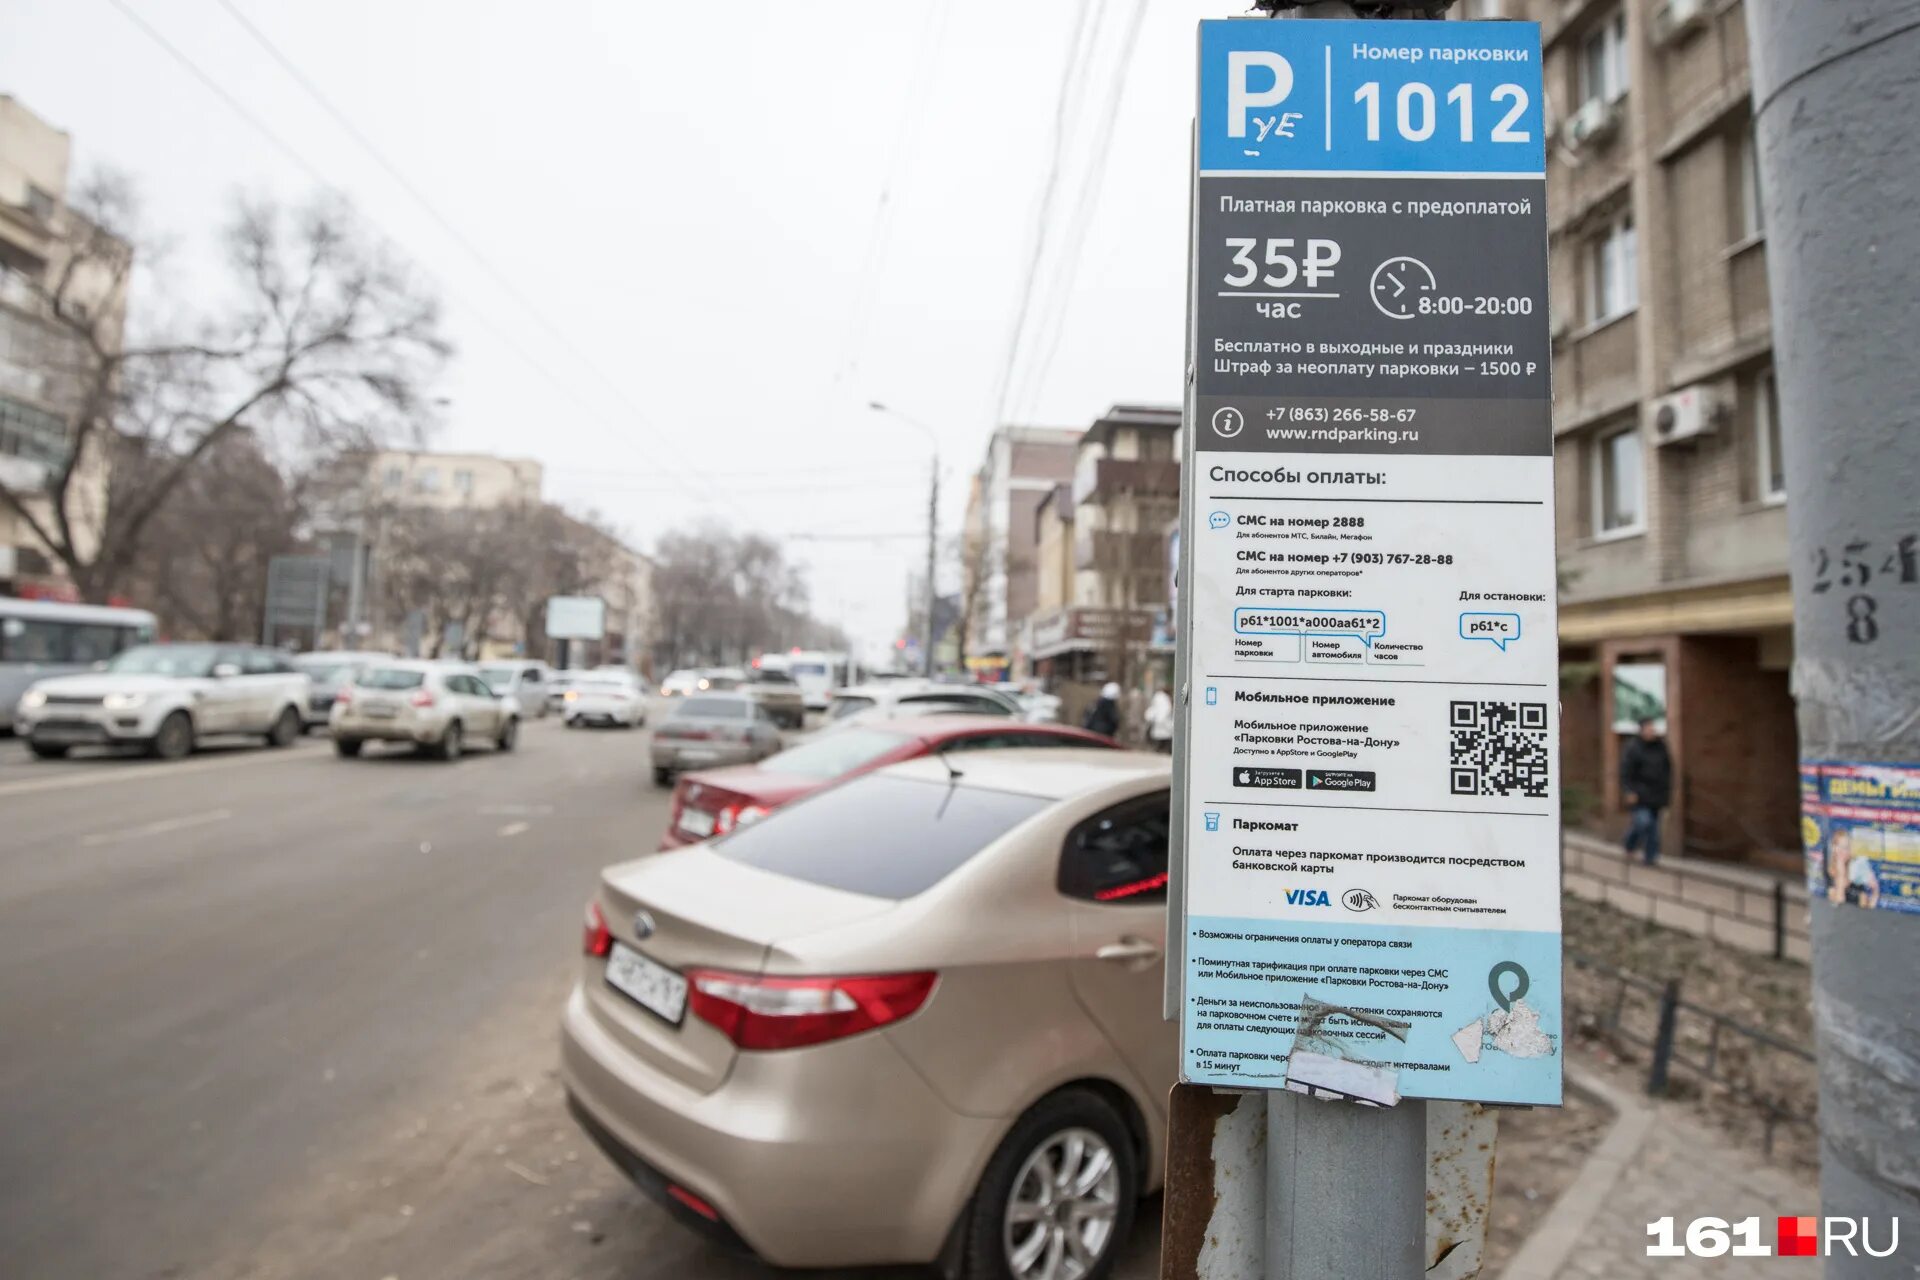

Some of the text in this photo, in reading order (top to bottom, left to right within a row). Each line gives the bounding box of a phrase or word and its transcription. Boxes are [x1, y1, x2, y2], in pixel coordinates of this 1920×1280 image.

[1353, 43, 1529, 65] Номер парковки
[1228, 51, 1296, 140] P
[1354, 82, 1530, 143] 1012
[1220, 195, 1531, 218] Платная парковка с предоплатой
[1255, 302, 1302, 319] час
[1214, 337, 1514, 359] Бесплатно в выходные и праздники
[1213, 358, 1272, 377] Штраф
[1275, 362, 1293, 374] за
[1296, 362, 1376, 379] неоплату
[1379, 363, 1460, 379] парковки
[1480, 361, 1522, 377] 1500
[1265, 406, 1417, 423] +7 (863) 266-58-67
[1265, 426, 1419, 445] www.rndparking.ru
[1209, 465, 1387, 485] Способы оплаты:
[1236, 514, 1365, 530] СМС на номер 2888
[1236, 530, 1372, 542] Для абонентов МТС, Билайн, Мегафон
[1236, 550, 1454, 566] СМС на номер +7 (903) 767-28-88
[1235, 566, 1250, 576] Для
[1251, 567, 1289, 576] абонентов
[1290, 569, 1315, 577] других
[1234, 585, 1352, 599] Для старта парковки:
[1458, 590, 1546, 602] Для остановки:
[1847, 594, 1877, 643] 8
[1235, 638, 1263, 649] Номер
[1312, 640, 1340, 651] Номер
[1374, 641, 1423, 651] Количество
[1235, 649, 1273, 658] парковки
[1312, 650, 1362, 660] автомобиля
[1374, 653, 1398, 661] часов
[1234, 690, 1396, 708] Мобильное приложение
[1233, 719, 1369, 734] Мобильное приложение
[1233, 732, 1401, 750] «Парковки Ростова-на-Дону»
[1233, 746, 1270, 757] Доступно
[1276, 747, 1309, 757] AppStore
[1316, 749, 1358, 760] GooglePlay
[1253, 775, 1296, 787] App Store
[1325, 777, 1371, 789] Google Play
[1232, 817, 1300, 833] Паркомат
[1231, 845, 1526, 868] Оплата через паркомат производится посредством
[1231, 859, 1335, 876] банковской карты
[1283, 888, 1331, 907] VISA
[1393, 893, 1477, 906] Паркомат оборудован
[1391, 901, 1506, 915] бесконтактным считывателем
[1198, 928, 1412, 950] Возможны ограничения оплаты у оператора связи
[1197, 956, 1448, 979] Поминутная тарификация при оплате парковки через СМС
[1198, 969, 1450, 993] или Мобильное приложение «Парковки Ростова-на-Дону»
[1195, 995, 1228, 1007] Деньги
[1229, 999, 1238, 1008] за
[1386, 1008, 1442, 1019] сохраняются
[1197, 1009, 1207, 1018] на
[1209, 1010, 1266, 1021] парковочном
[1268, 1013, 1292, 1023] счете
[1293, 1015, 1300, 1024] и
[1328, 1015, 1349, 1026] быть
[1196, 1021, 1211, 1031] для
[1213, 1022, 1244, 1032] оплаты
[1245, 1024, 1296, 1036] следующих
[1355, 1029, 1386, 1040] сессий
[1195, 1047, 1228, 1059] Оплата
[1229, 1051, 1269, 1062] парковки
[1393, 1061, 1450, 1072] интервалами
[1196, 1059, 1240, 1073] в 15 минут
